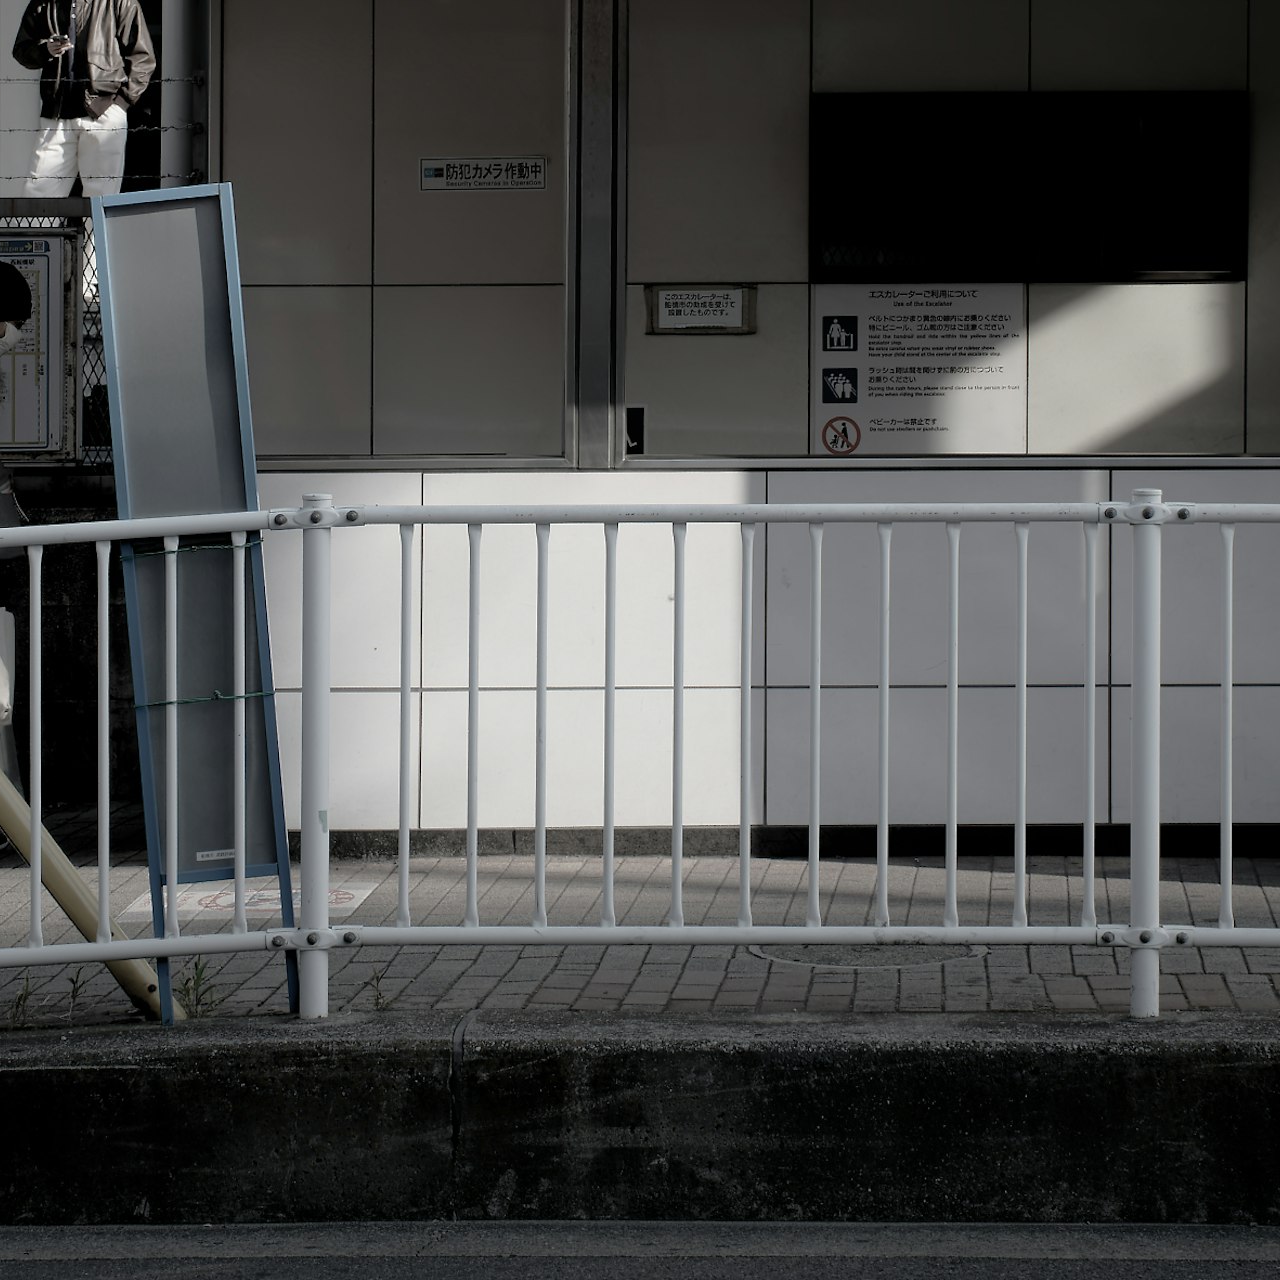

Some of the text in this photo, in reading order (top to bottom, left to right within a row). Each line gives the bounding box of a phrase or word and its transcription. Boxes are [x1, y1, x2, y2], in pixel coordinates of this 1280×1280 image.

[446, 162, 542, 180] 防犯カメラ作動中
[868, 290, 979, 299] エスカレーターご利用について
